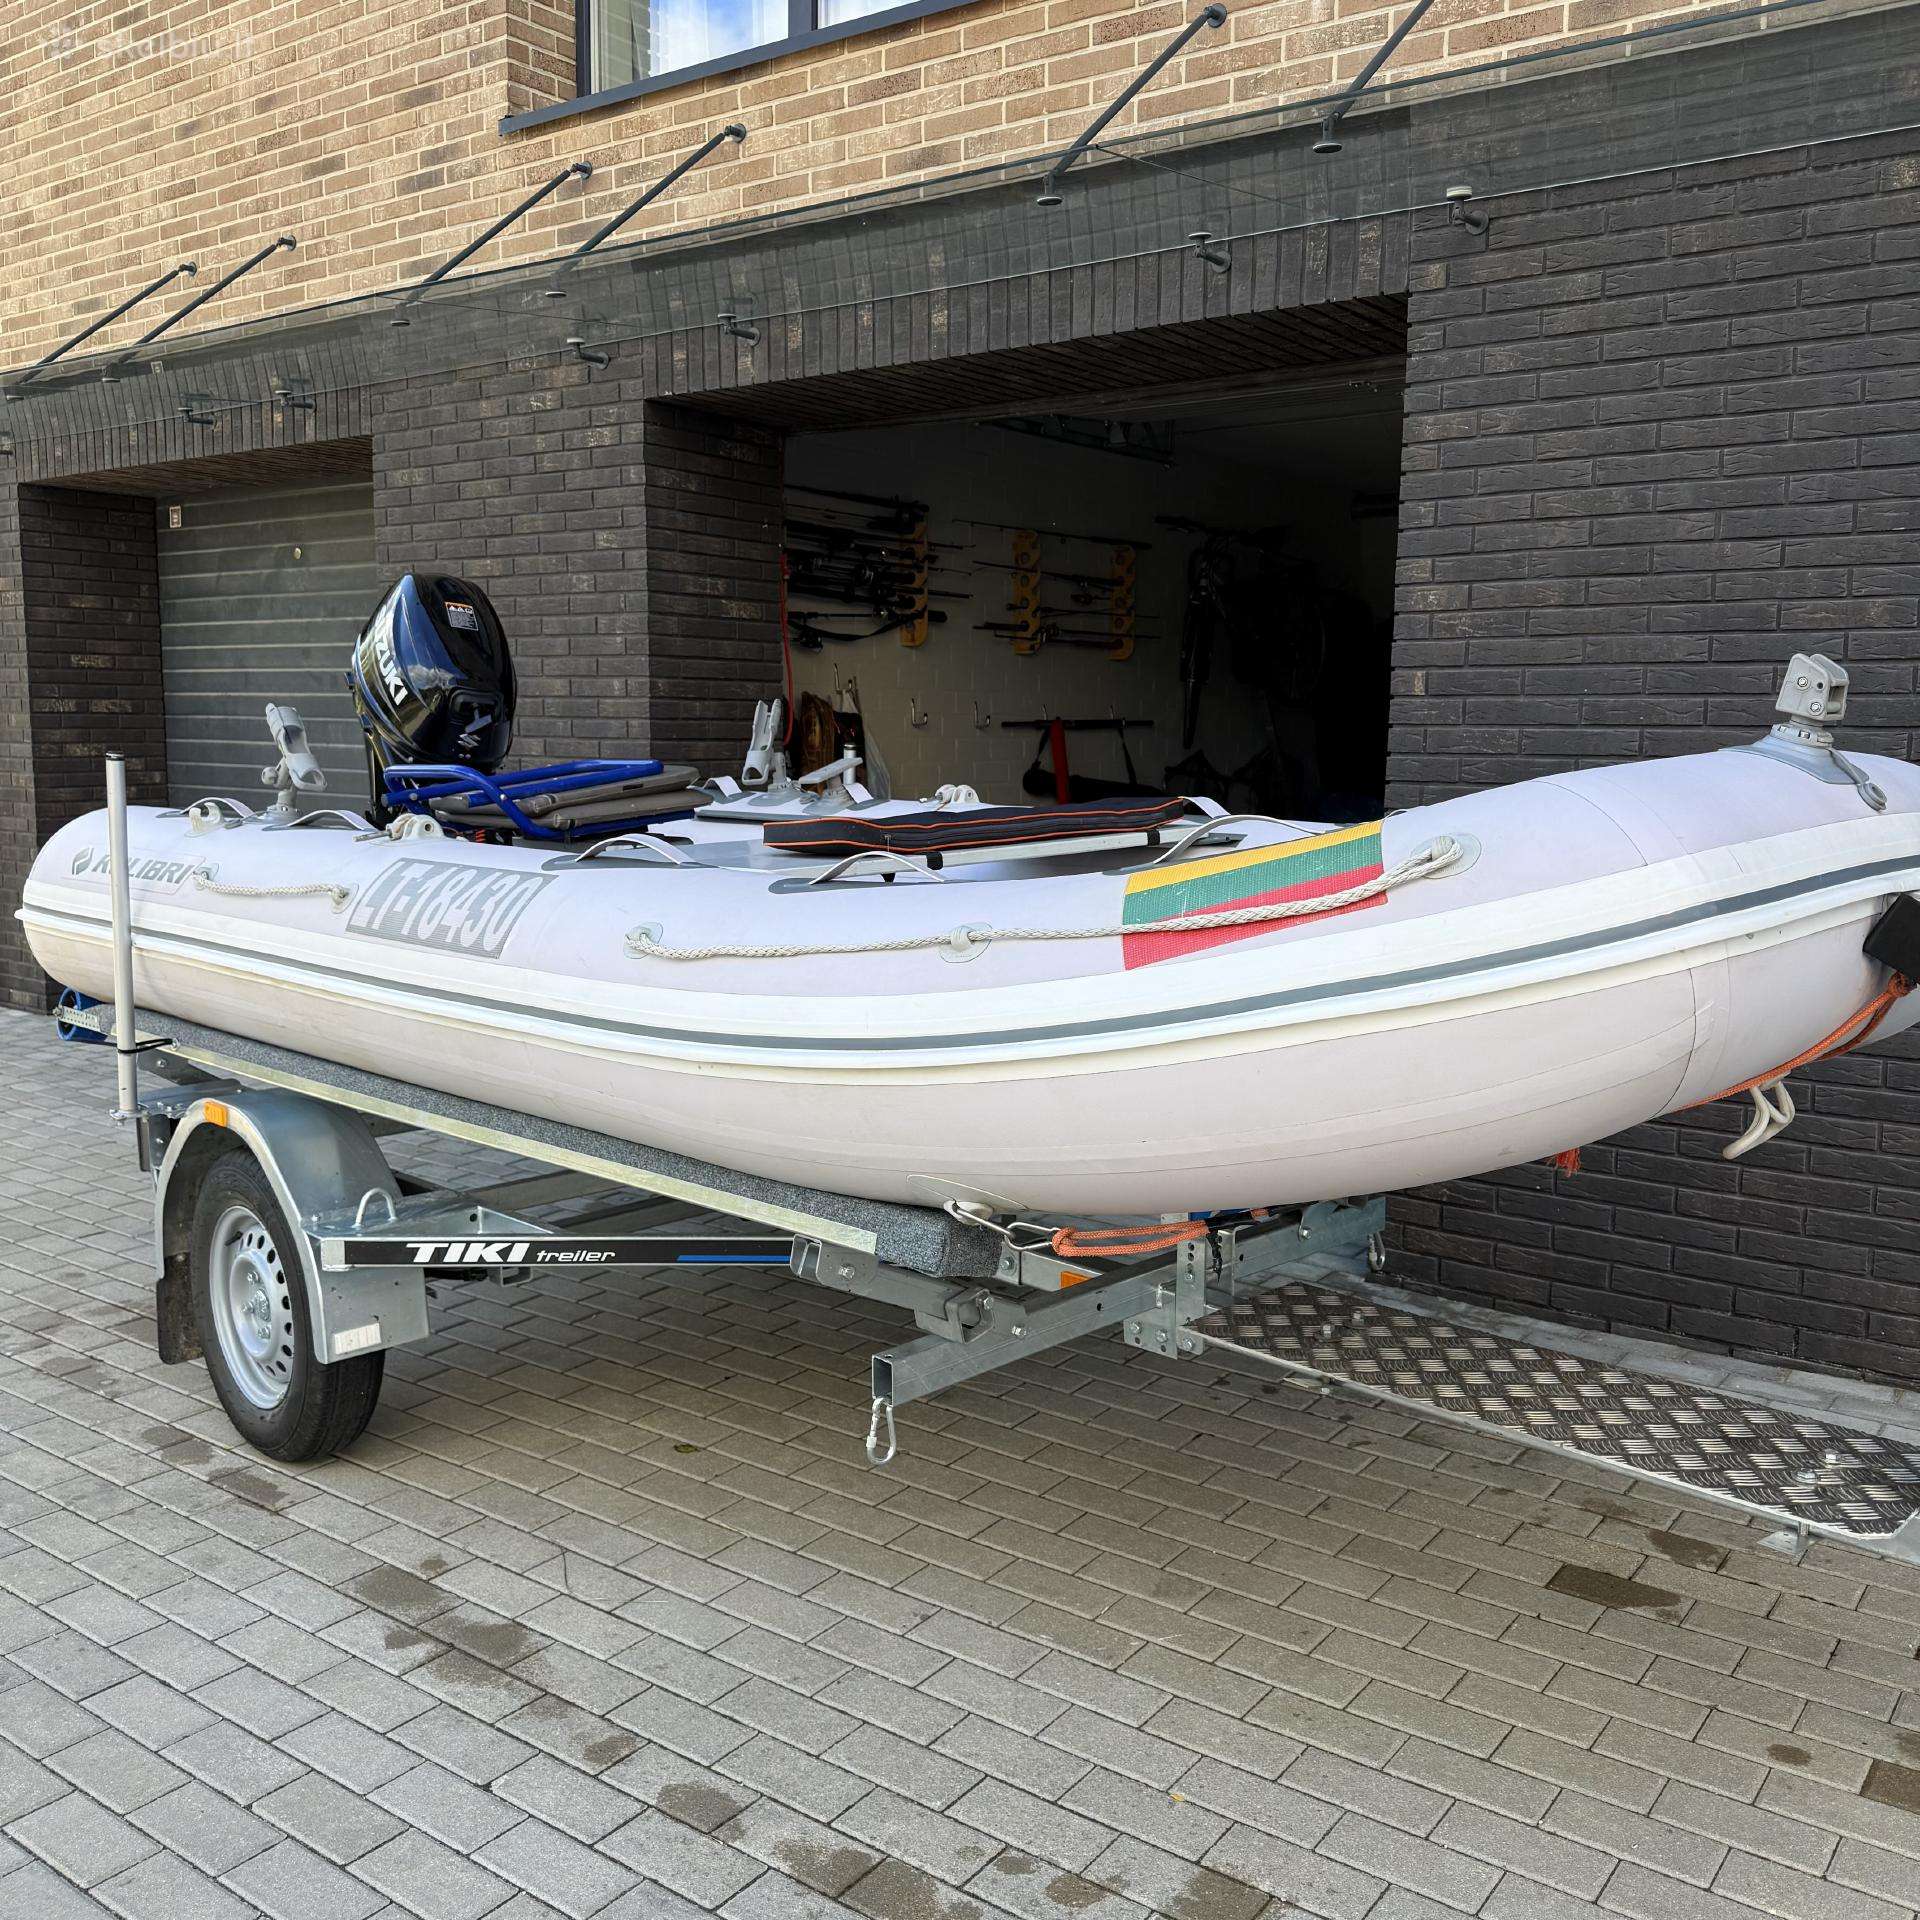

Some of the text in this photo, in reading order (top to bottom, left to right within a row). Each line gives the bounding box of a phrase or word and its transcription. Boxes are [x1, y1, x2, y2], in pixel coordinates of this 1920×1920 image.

[91, 854, 195, 884] KLIBRI
[350, 861, 544, 952] LT-18430
[406, 1242, 616, 1263] TIKI treiler
